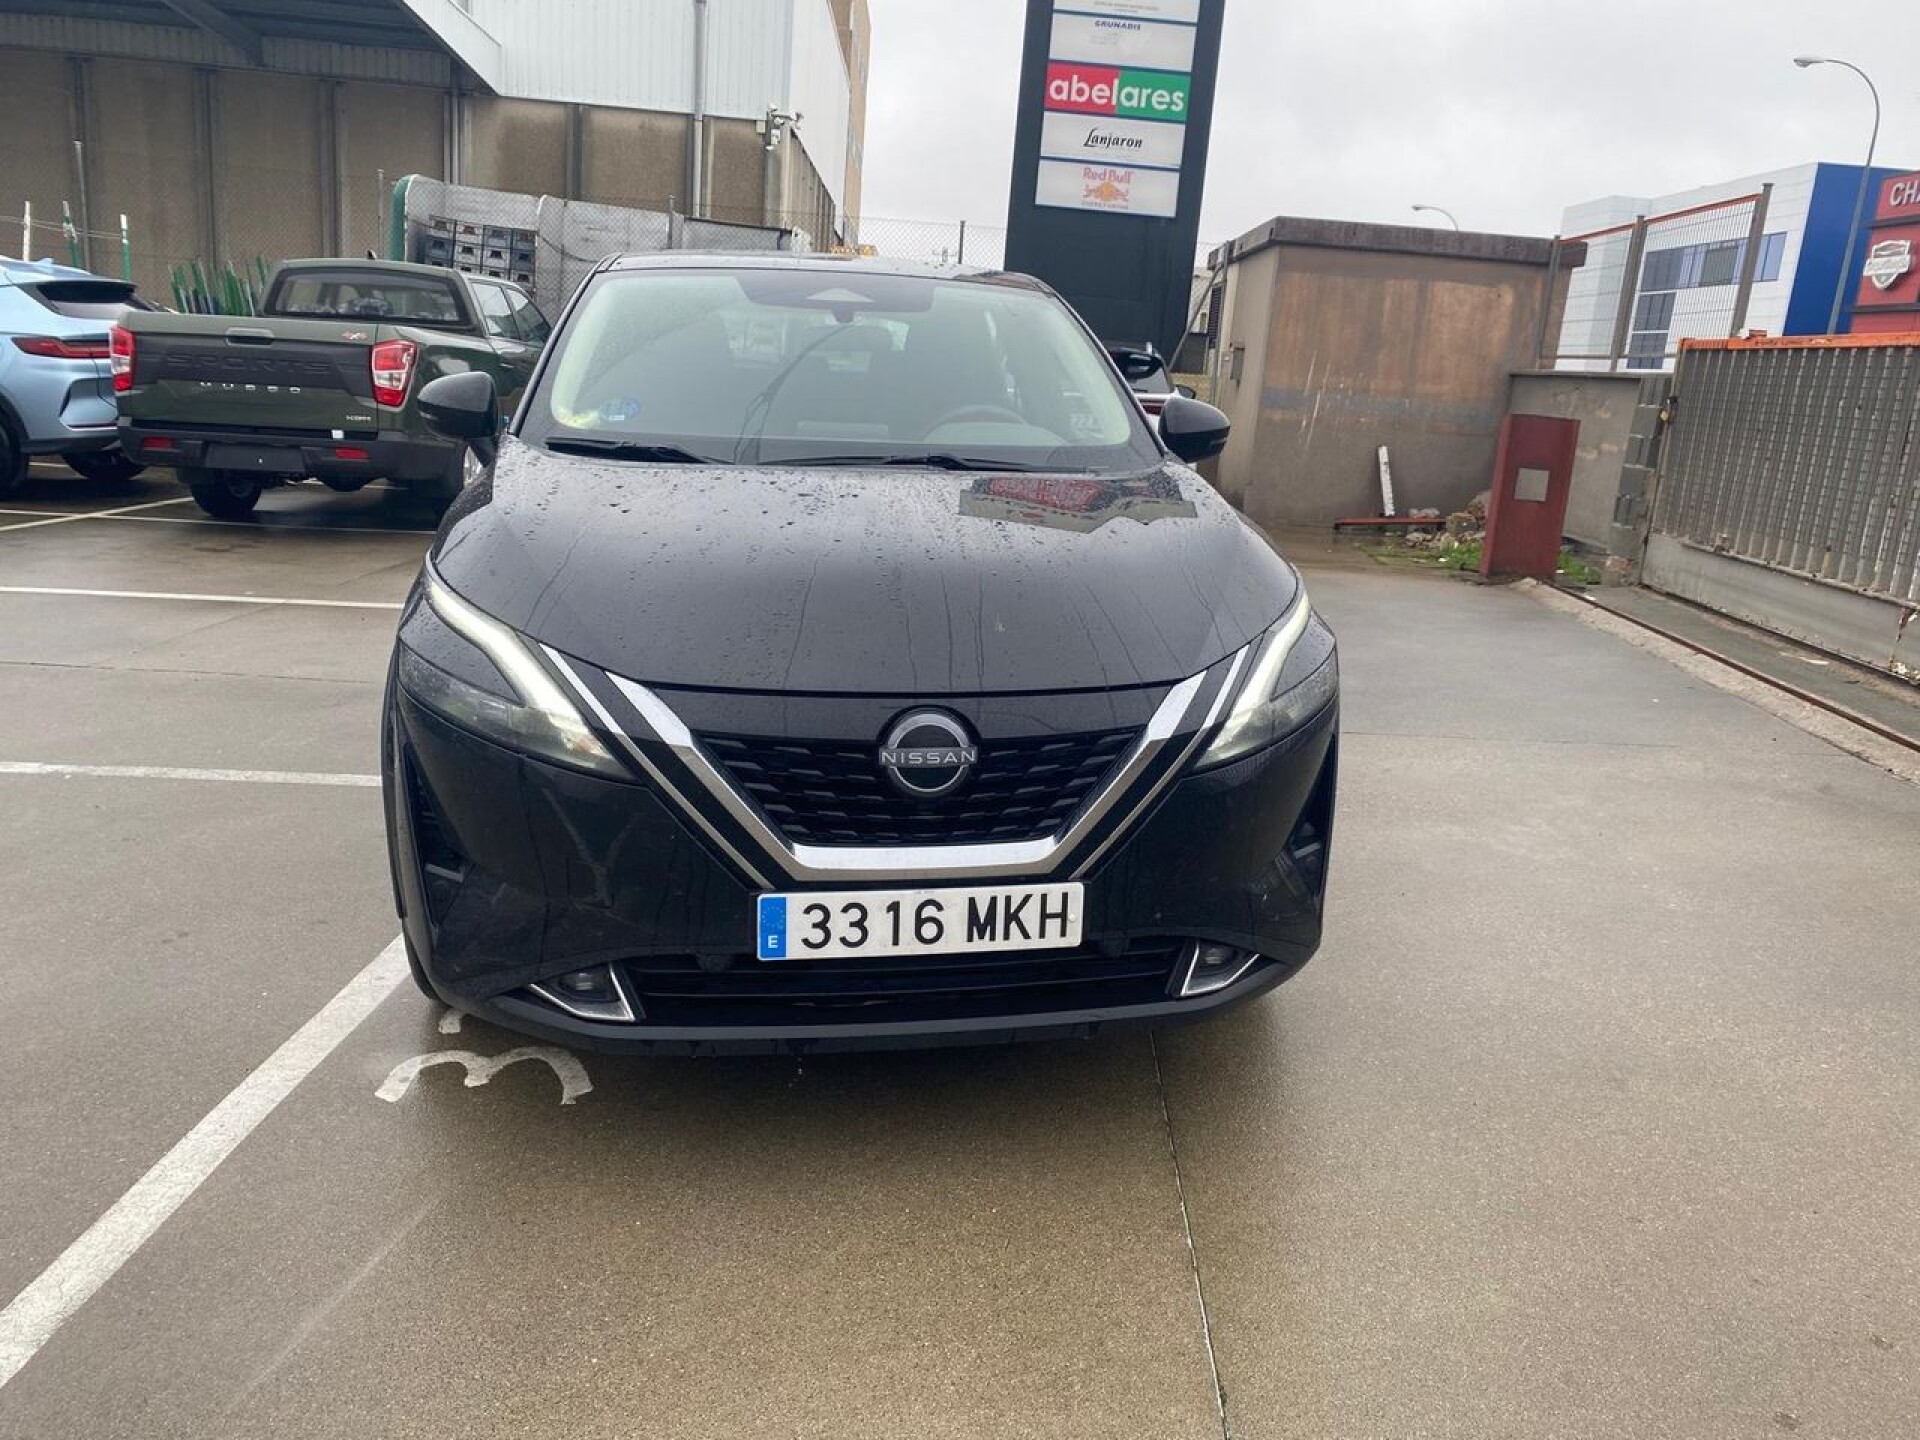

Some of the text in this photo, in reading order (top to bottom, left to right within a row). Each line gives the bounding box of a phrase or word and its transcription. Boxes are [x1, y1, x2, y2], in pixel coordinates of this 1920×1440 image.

[1050, 75, 1184, 112] abelares
[1083, 167, 1131, 184] Red Bull
[1890, 179, 1920, 206] CH
[881, 749, 976, 765] NISSAN
[767, 892, 1070, 950] E 3316 MKH
